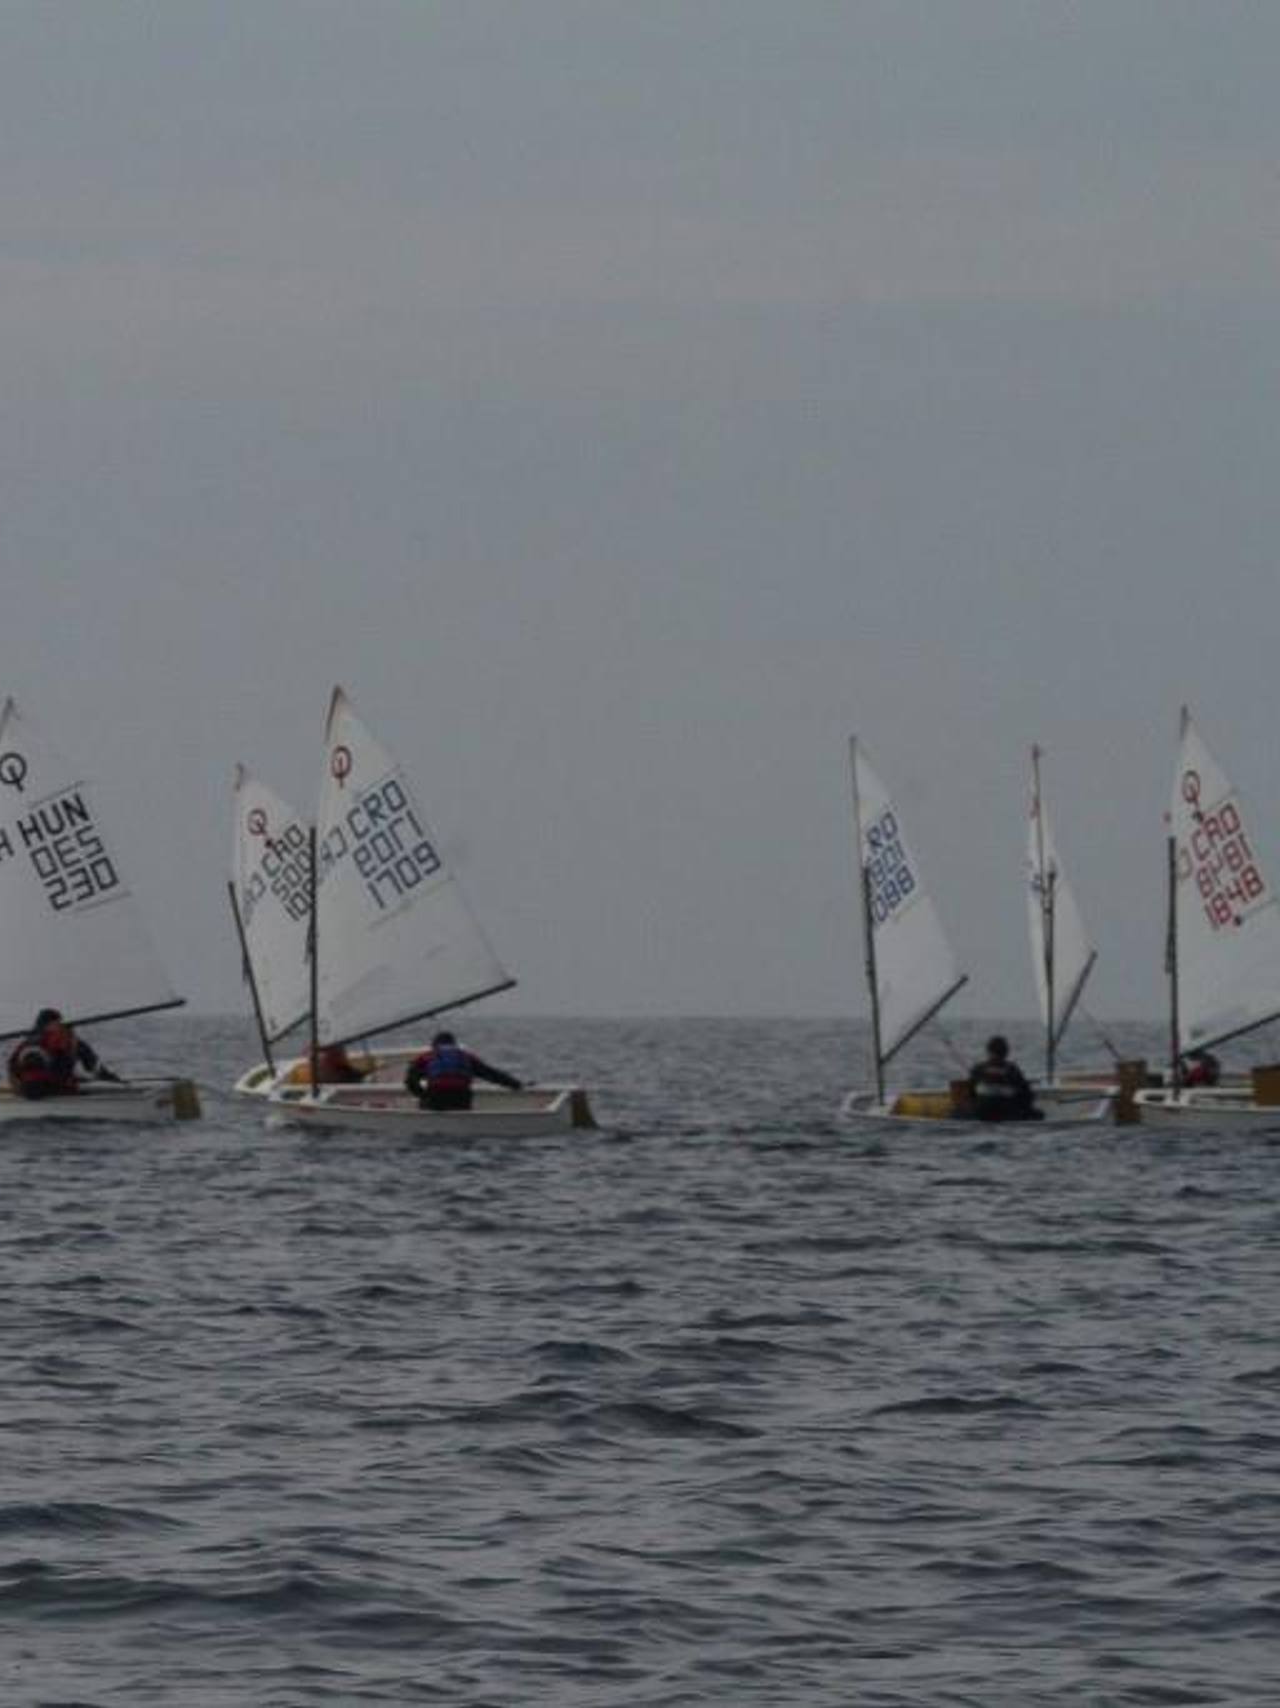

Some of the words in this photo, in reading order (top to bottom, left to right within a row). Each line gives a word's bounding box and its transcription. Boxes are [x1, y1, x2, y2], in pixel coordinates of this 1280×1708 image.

[17, 793, 90, 847] HUN
[347, 780, 407, 840] CRO
[867, 811, 898, 854] RO
[1192, 803, 1240, 861] CRO
[45, 857, 120, 911] 230
[367, 840, 441, 910] 1709
